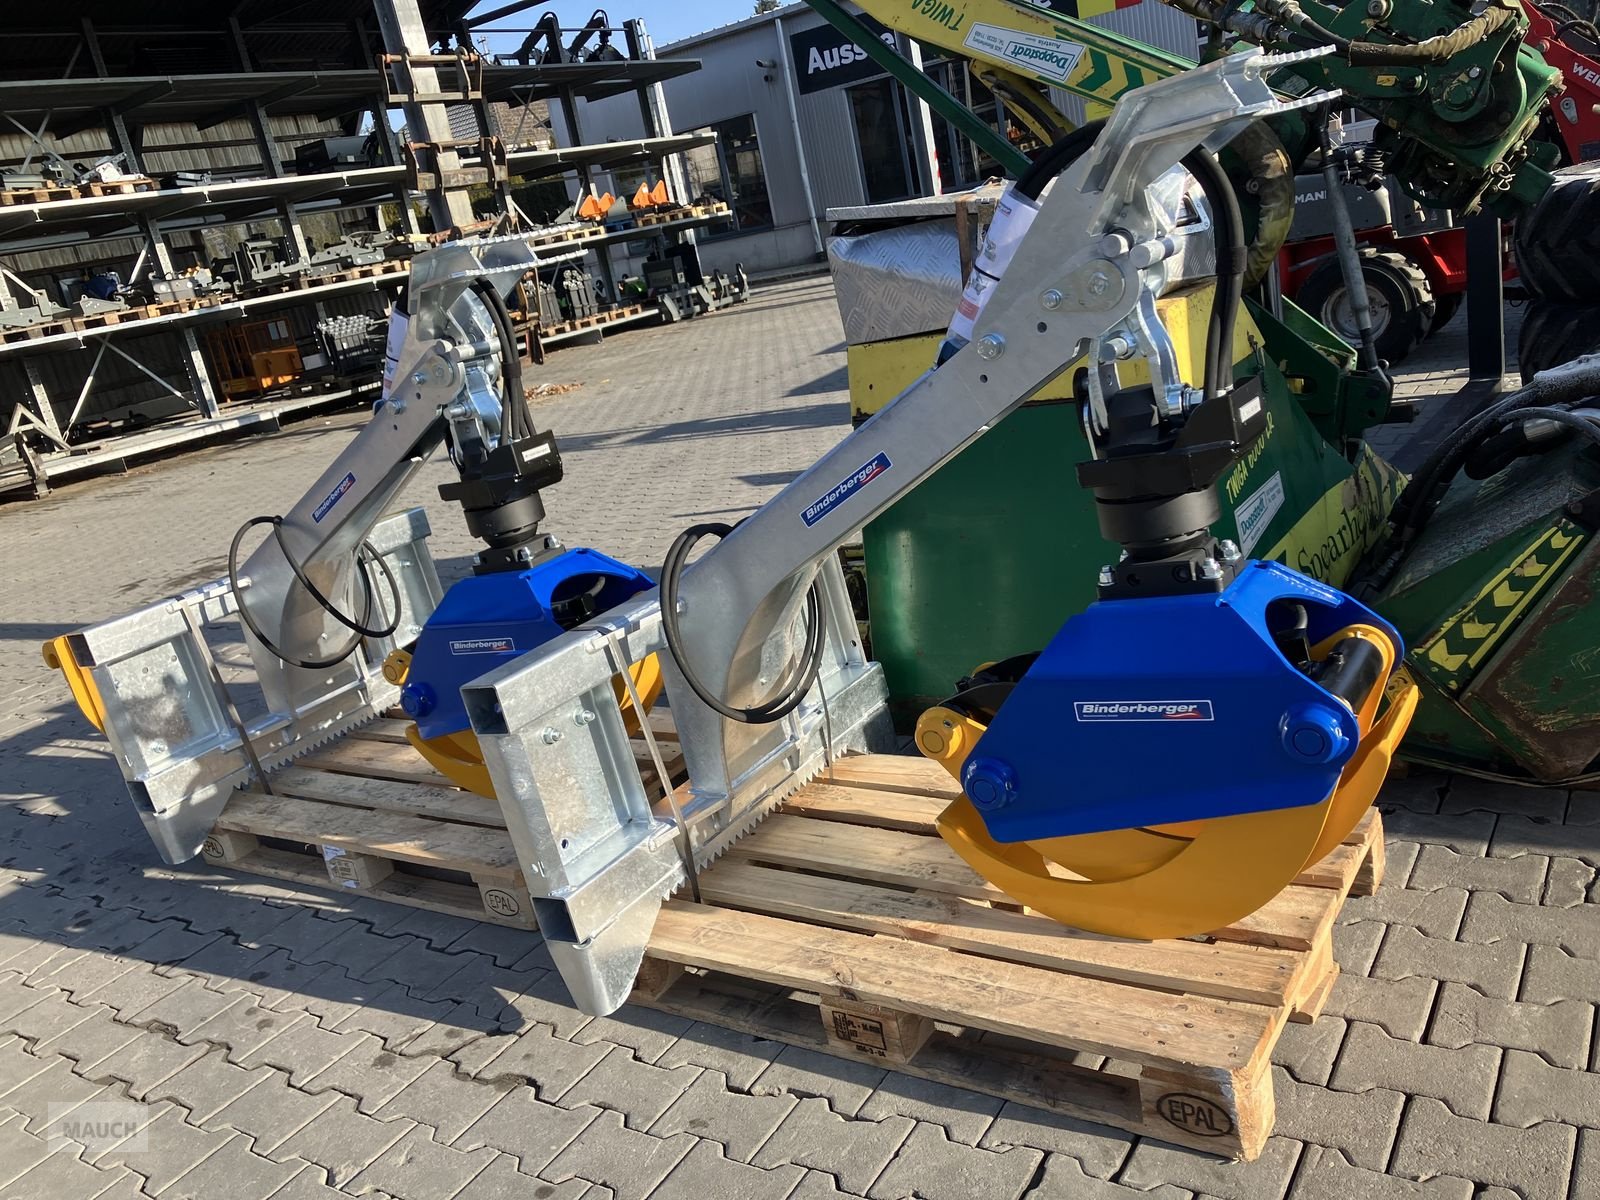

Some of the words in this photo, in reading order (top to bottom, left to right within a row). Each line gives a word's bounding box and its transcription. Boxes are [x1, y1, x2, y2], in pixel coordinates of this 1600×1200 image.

[1010, 44, 1069, 69] Doppstadt
[314, 477, 349, 518] Binderberger
[805, 460, 878, 519] Binderberger
[454, 641, 507, 650] Binderberger
[1082, 704, 1197, 714] Binderberger
[488, 894, 516, 912] EPAL
[1168, 1099, 1224, 1133] EPAL
